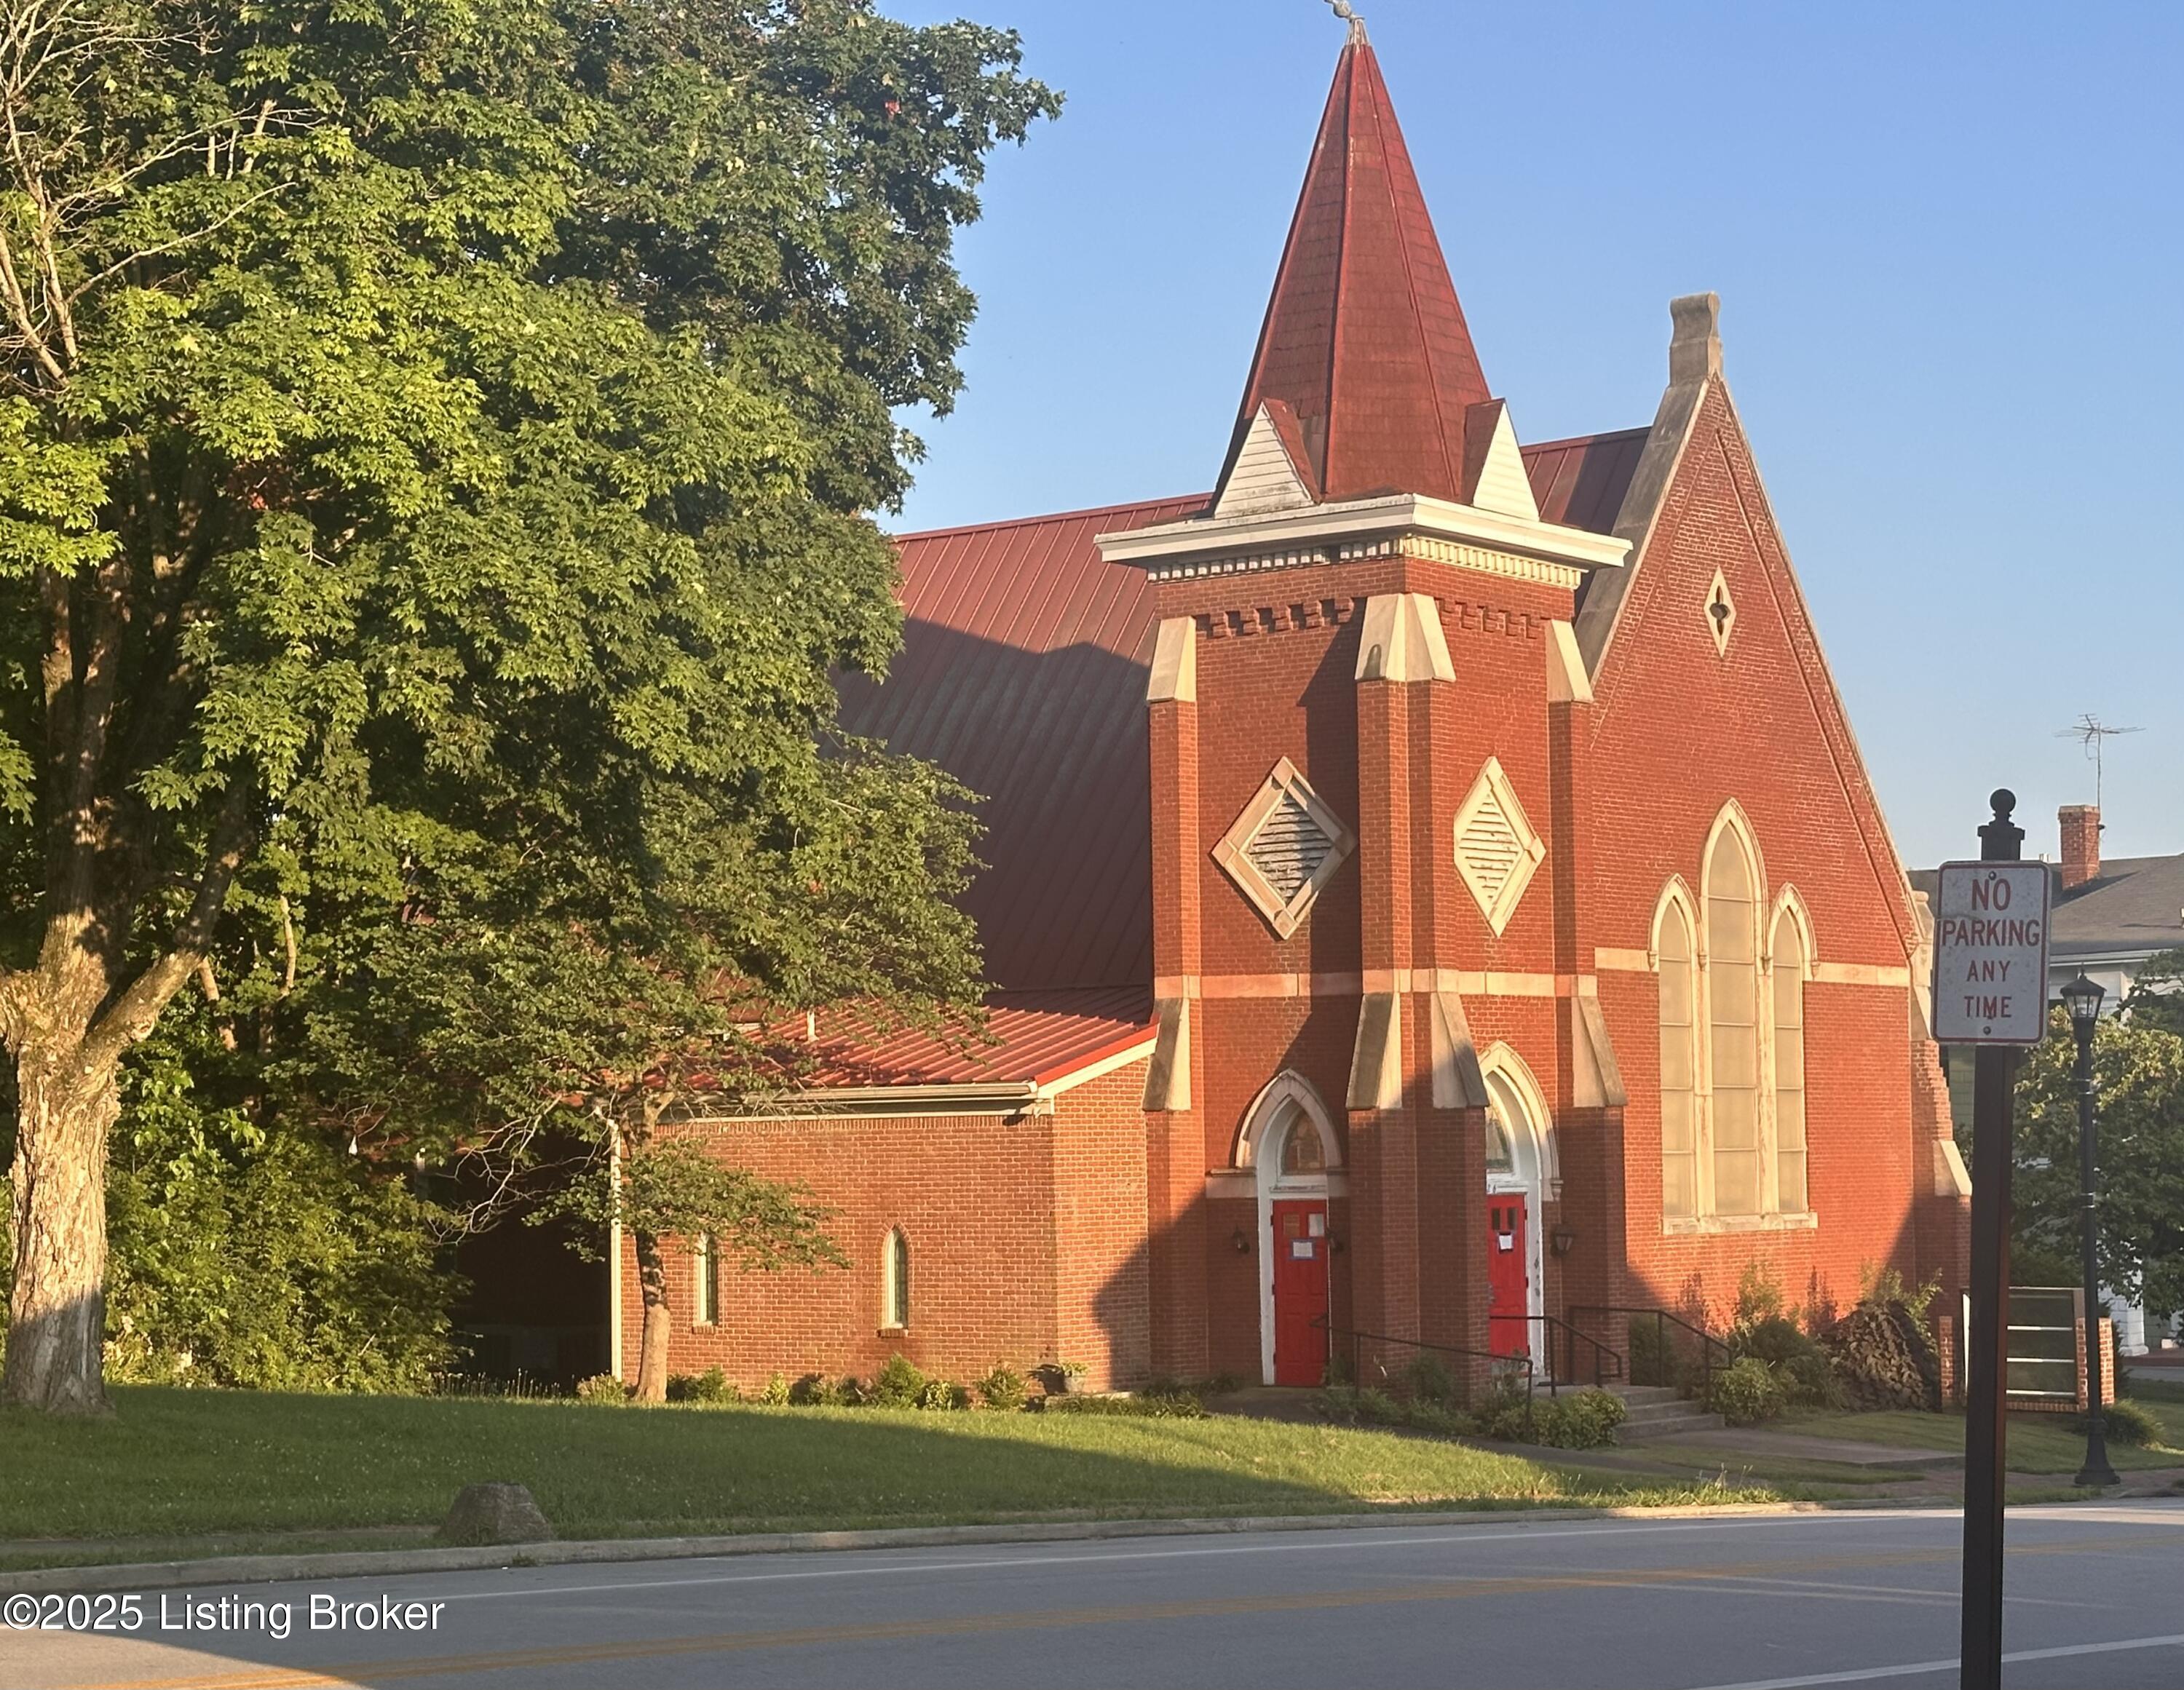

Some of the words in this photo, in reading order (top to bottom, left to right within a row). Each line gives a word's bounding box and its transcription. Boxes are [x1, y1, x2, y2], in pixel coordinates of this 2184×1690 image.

[1971, 878, 2011, 911] NO
[1942, 919, 2040, 946] PARKING
[1967, 960, 2011, 983] ANY
[1964, 996, 2012, 1017] TIME
